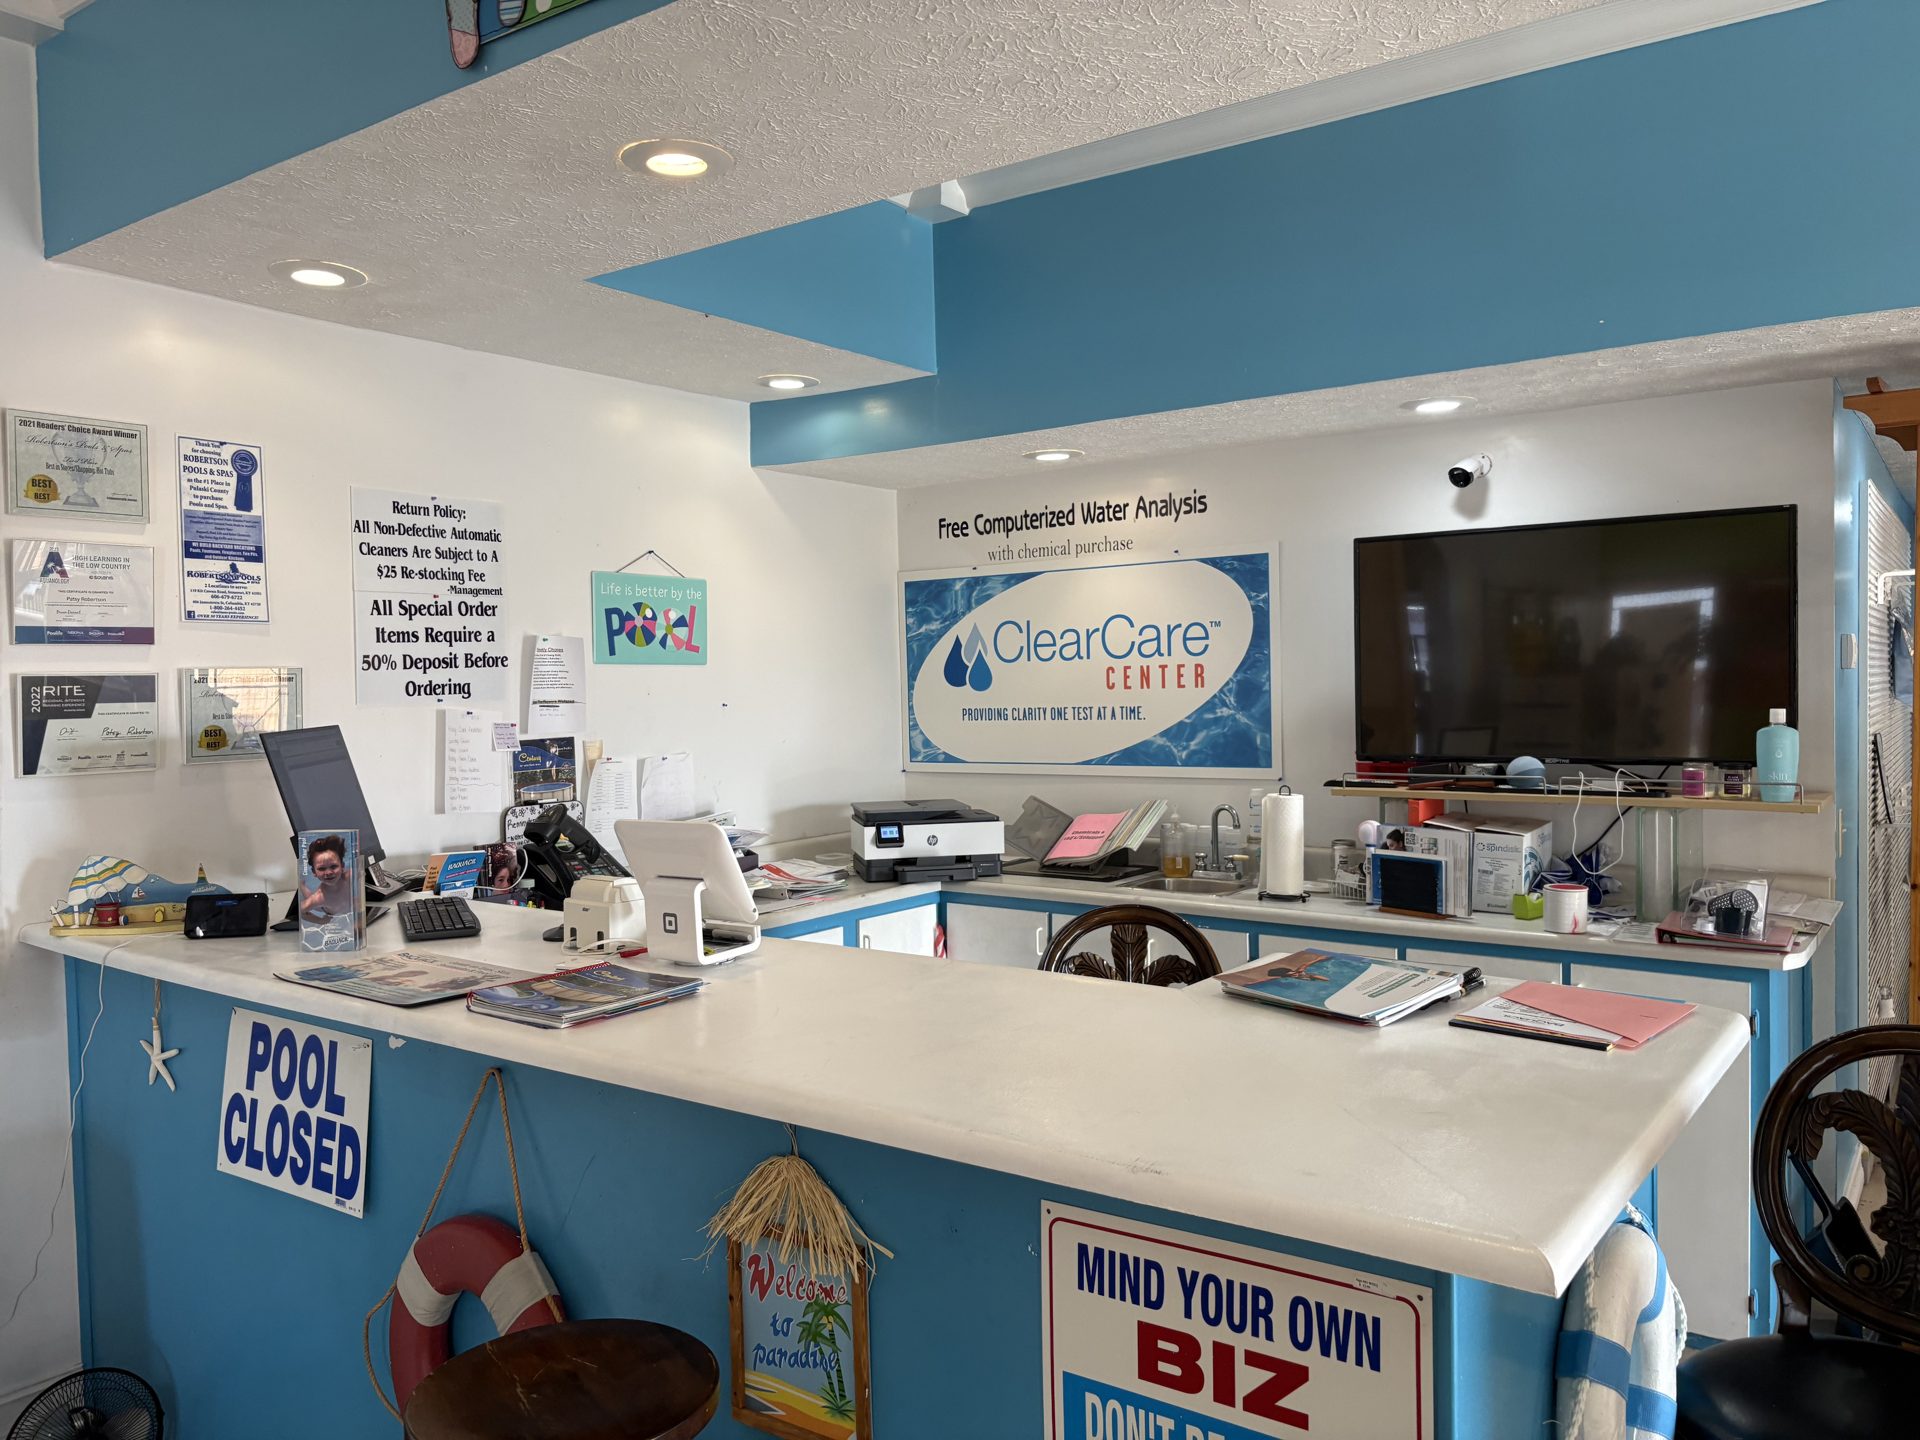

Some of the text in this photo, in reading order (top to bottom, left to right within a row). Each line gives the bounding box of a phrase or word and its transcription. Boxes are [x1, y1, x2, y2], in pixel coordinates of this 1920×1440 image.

[19, 419, 35, 428] 2021
[67, 425, 91, 434] Choice
[92, 428, 113, 437] Award
[114, 430, 138, 440] Winner
[183, 454, 229, 466] ROBERTSON
[183, 465, 208, 475] POOLS
[216, 469, 234, 478] SPAS
[32, 479, 52, 488] BEST
[392, 501, 467, 523] Return Policy:
[938, 489, 1208, 539] Free Computerized Water Analysis
[353, 519, 502, 543] All Non-Defective Automatic
[358, 542, 499, 564] Cleaners Are Subject to A
[988, 536, 1134, 562] with chemical purchase
[376, 564, 486, 585] $25 Re-stocking Fee
[601, 583, 702, 600] Life is better by the
[370, 599, 498, 621] All Special Order
[375, 626, 495, 648] Items Require a
[604, 601, 701, 656] POOL
[361, 652, 509, 675] 50% Deposit Before
[1105, 663, 1205, 690] CENTER
[43, 685, 85, 697] RITE
[405, 677, 471, 699] Ordering
[32, 686, 41, 713] 2022
[962, 706, 1146, 721] PROVIDING CLARITY ONE TEST AT A TIME.
[204, 729, 222, 738] BEST
[246, 1021, 346, 1117] POOL
[224, 1092, 361, 1201] CLOSED
[747, 1252, 848, 1304] Welcome
[1077, 1242, 1381, 1373] MIND YOUR OWN
[770, 1312, 794, 1337] to
[753, 1341, 838, 1372] paradise
[1137, 1320, 1309, 1431] BIZ
